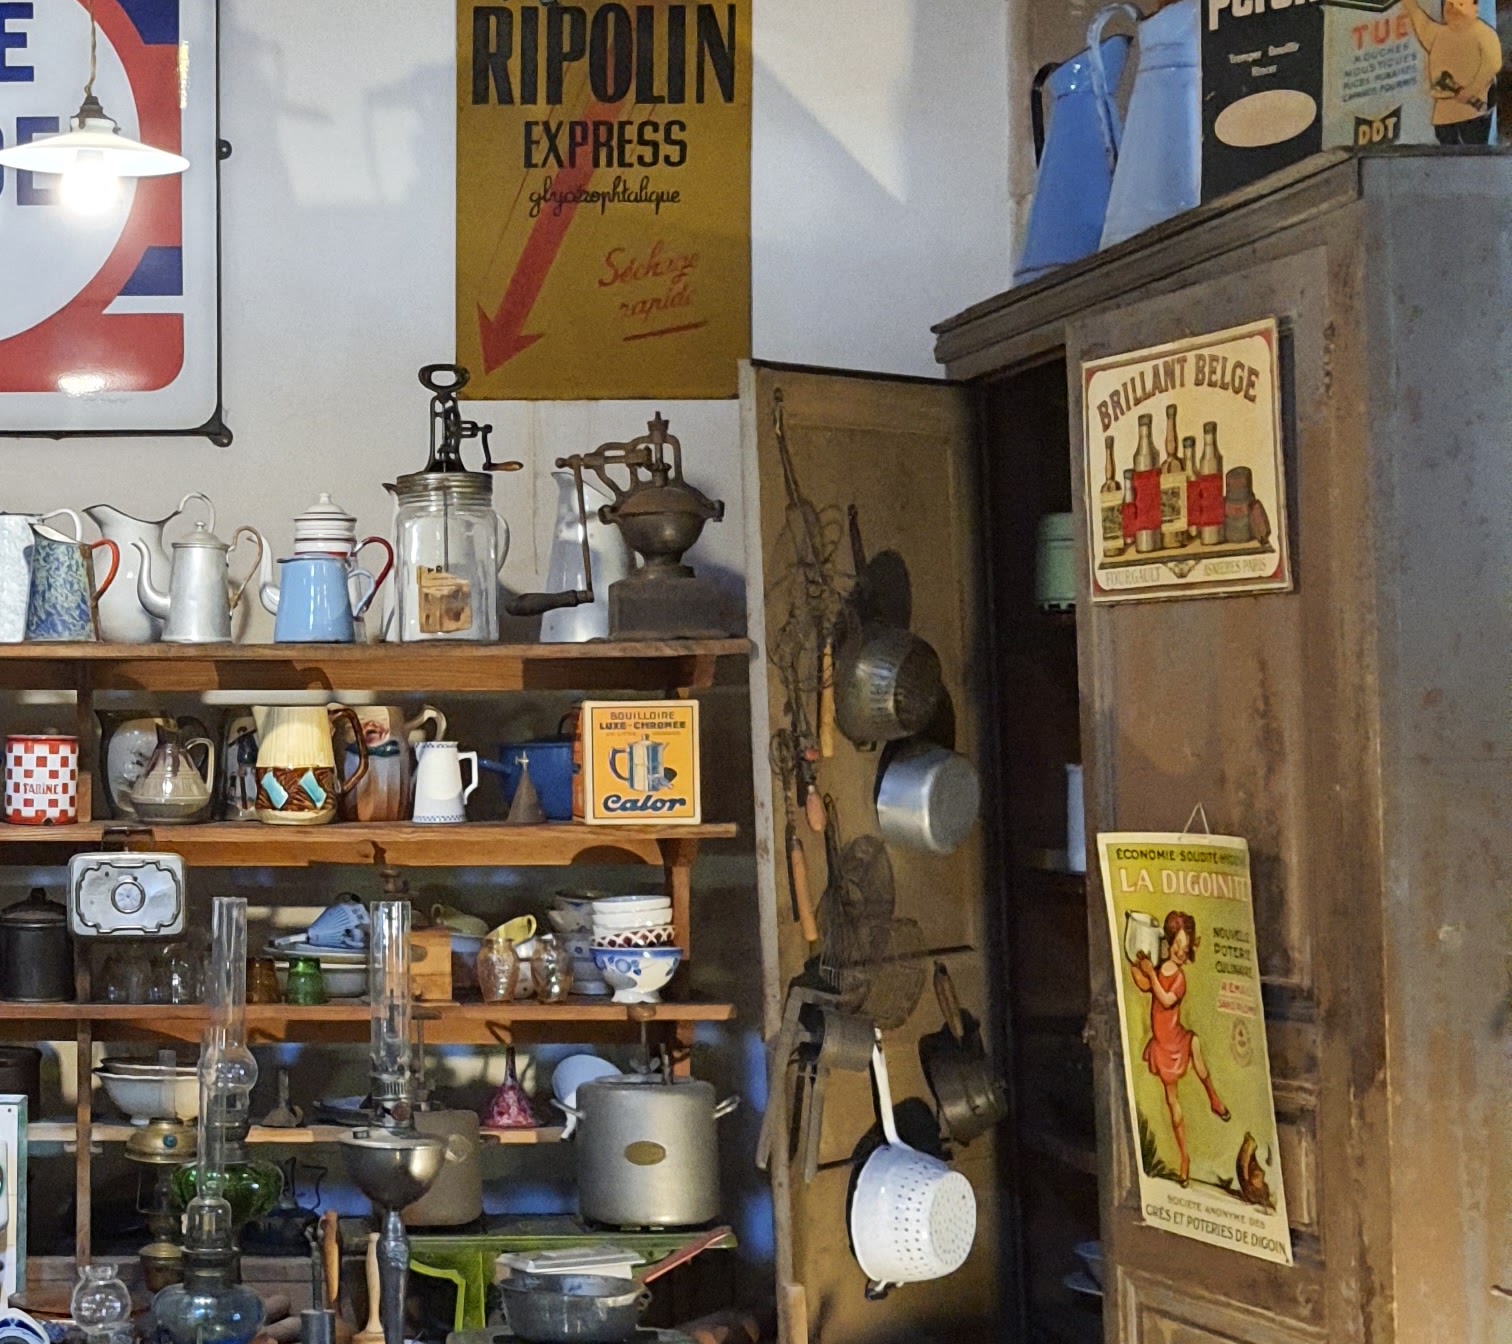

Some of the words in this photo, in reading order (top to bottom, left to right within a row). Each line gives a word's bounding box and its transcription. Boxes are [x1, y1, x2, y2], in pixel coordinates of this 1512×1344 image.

[1352, 13, 1409, 50] TUE
[472, 4, 737, 105] RIPOLIN
[524, 119, 689, 169] EXPRESS
[1358, 117, 1398, 146] DDT
[1096, 354, 1188, 433] BRILLANT
[1193, 353, 1260, 404] BELGE
[610, 711, 675, 721] BOUILLOIRE
[602, 793, 687, 813] Calor
[1119, 867, 1155, 893] LA
[1173, 1211, 1185, 1226] ET
[1187, 1215, 1234, 1240] POTERIES
[1235, 1228, 1249, 1245] DE
[1250, 1232, 1288, 1256] DIGOIN
